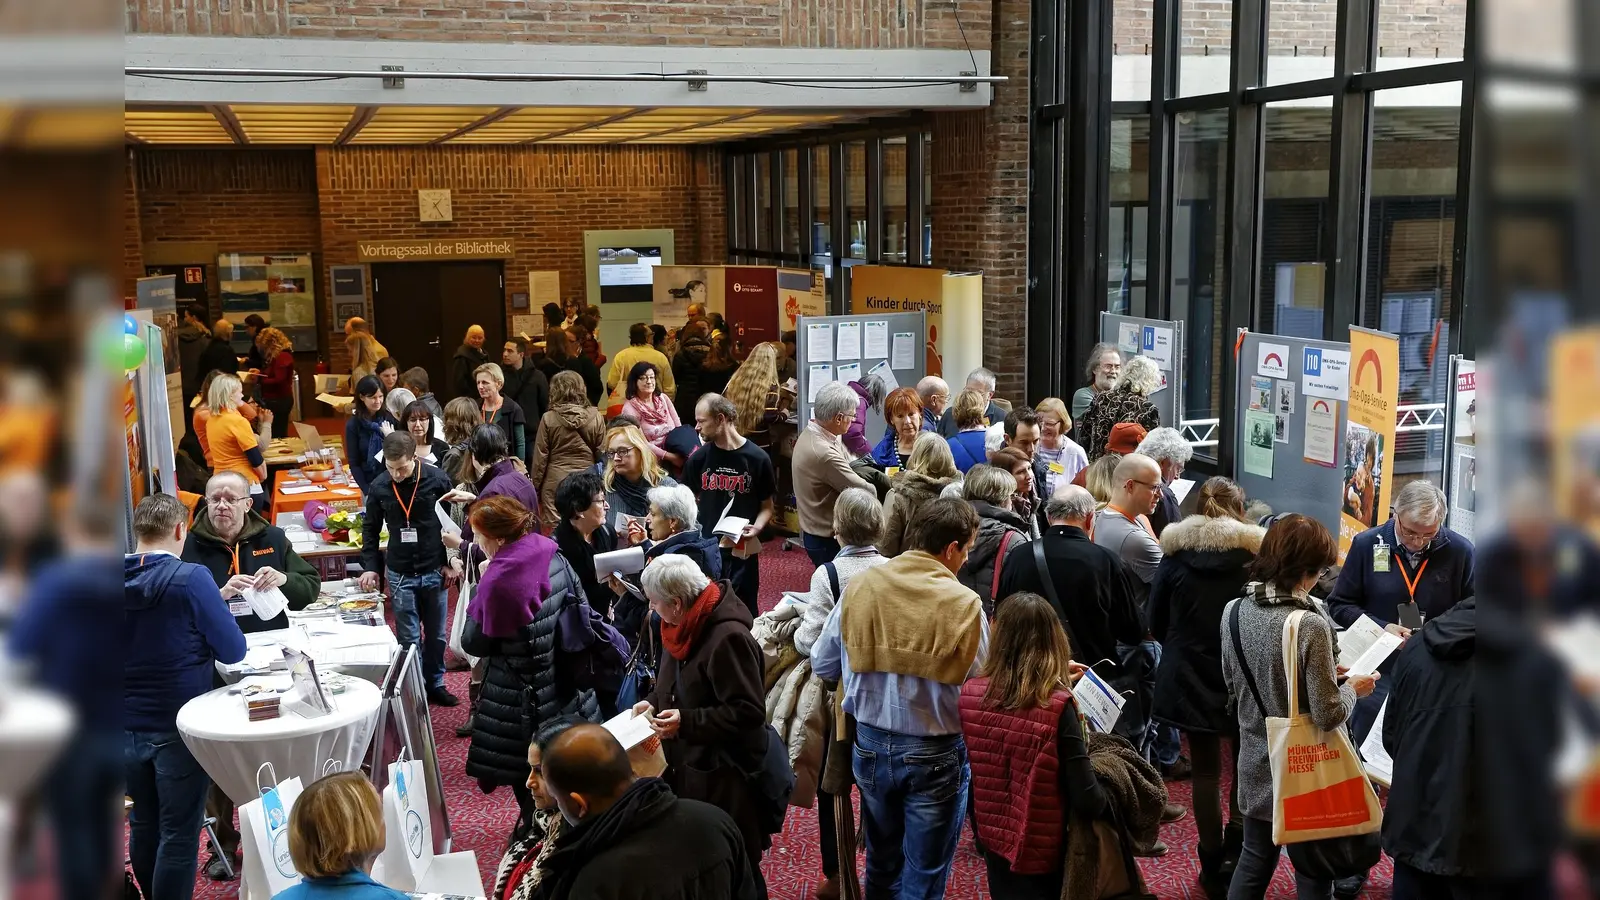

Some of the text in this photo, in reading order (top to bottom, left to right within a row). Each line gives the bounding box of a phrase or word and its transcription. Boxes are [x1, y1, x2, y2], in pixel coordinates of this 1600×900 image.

[360, 241, 511, 259] Vortragssaal der Bibliothek
[866, 296, 943, 315] Kinder durch Sport
[1306, 354, 1318, 370] J10
[1288, 763, 1315, 774] MESSE
[277, 849, 290, 863] unic
